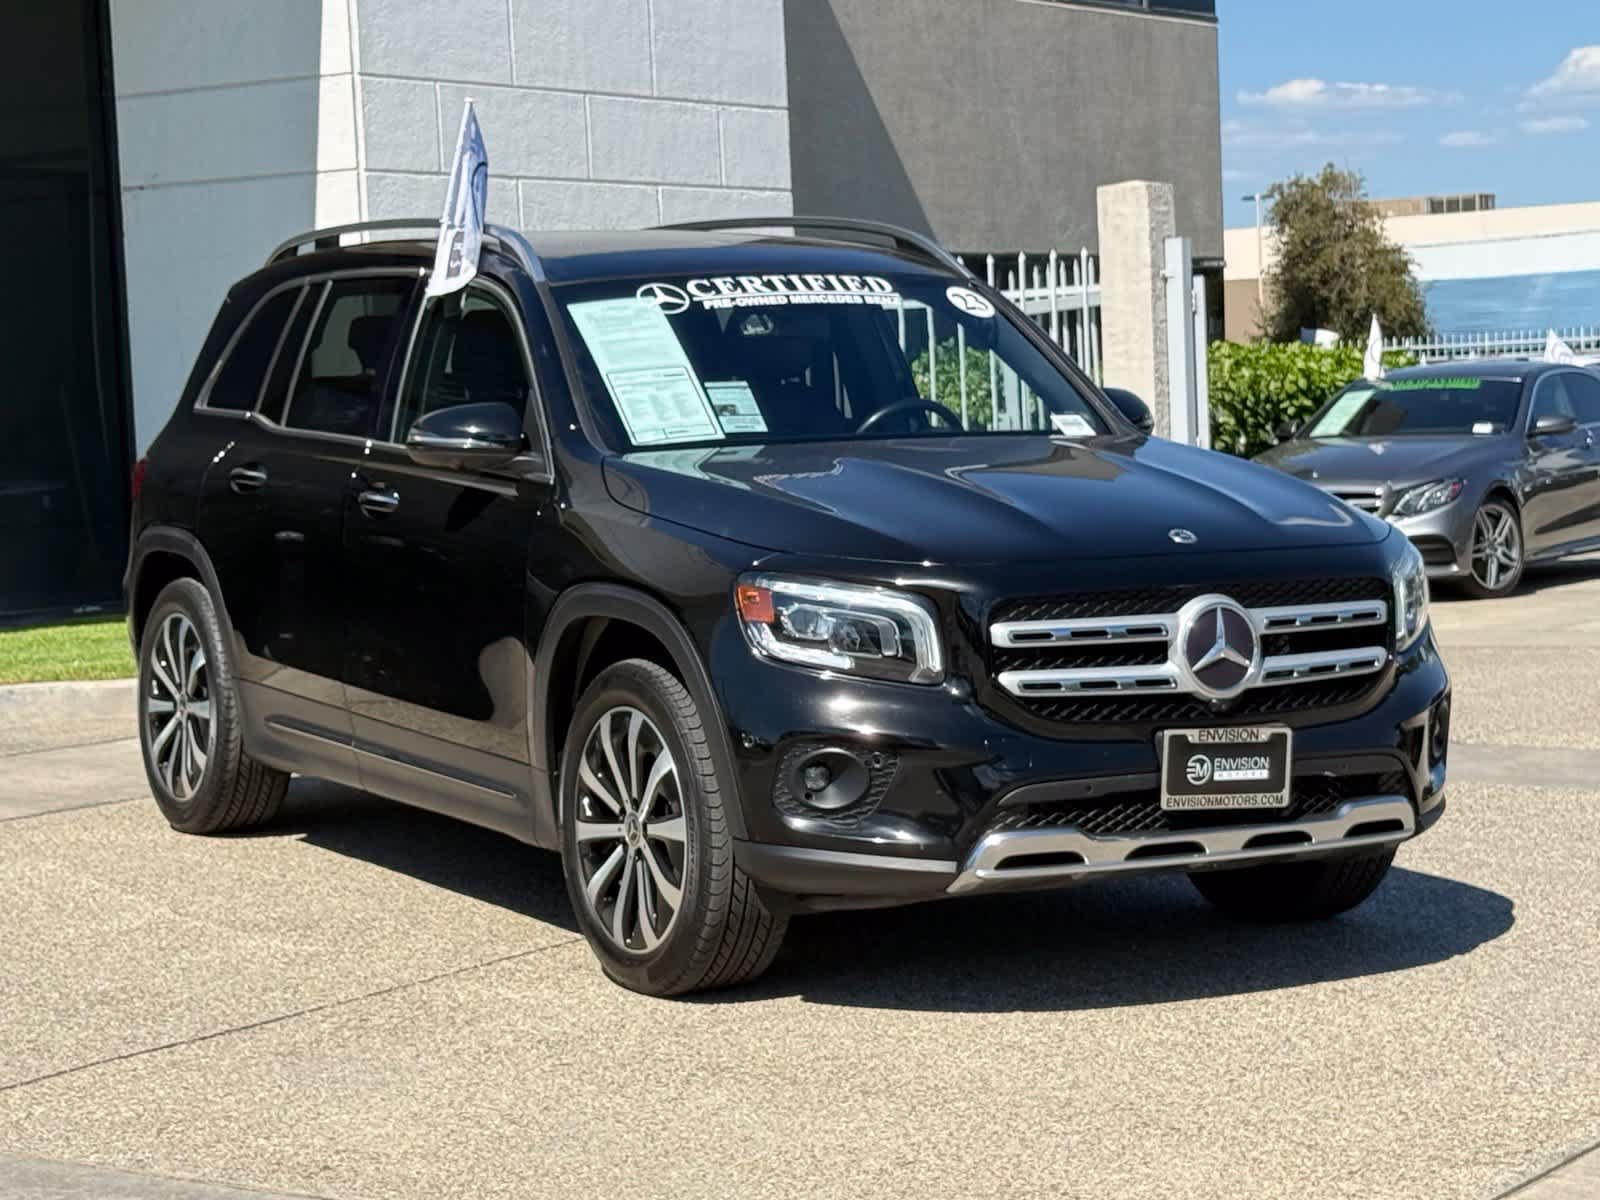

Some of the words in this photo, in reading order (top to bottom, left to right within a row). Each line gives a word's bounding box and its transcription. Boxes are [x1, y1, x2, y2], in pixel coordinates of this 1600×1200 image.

[686, 274, 894, 297] CERTIFIED
[951, 293, 989, 312] 23
[1198, 728, 1260, 742] ENVISION
[1213, 756, 1270, 770] ENVISION
[1166, 794, 1284, 809] ENVISIONMOTORS.COM
